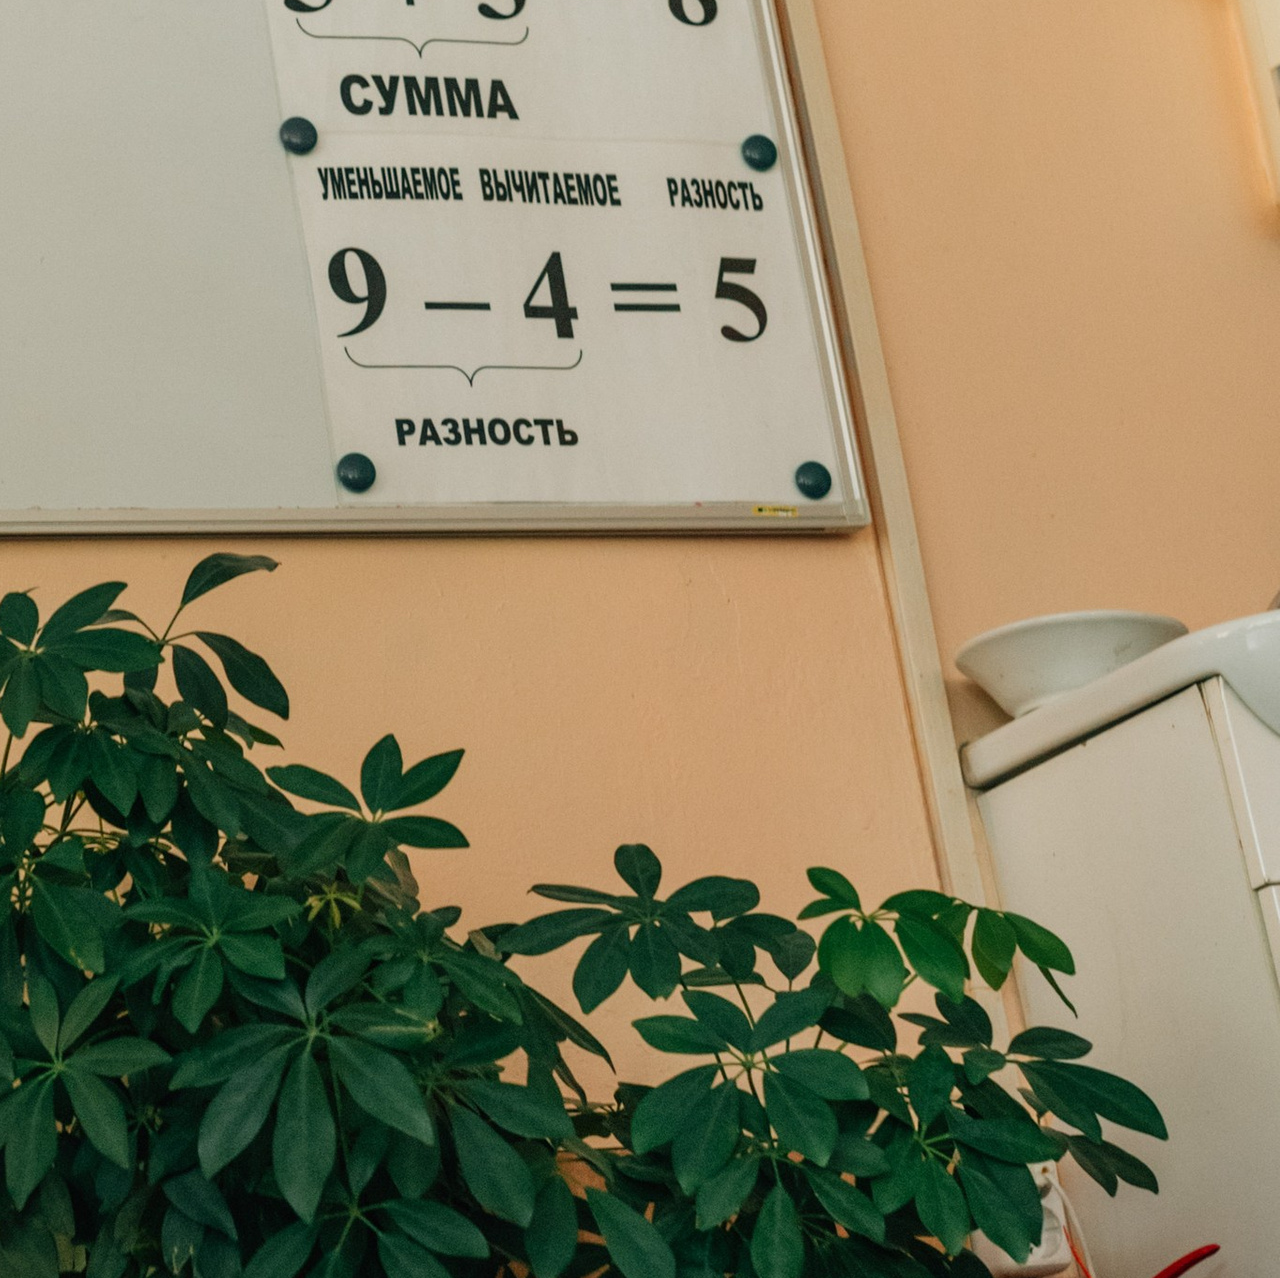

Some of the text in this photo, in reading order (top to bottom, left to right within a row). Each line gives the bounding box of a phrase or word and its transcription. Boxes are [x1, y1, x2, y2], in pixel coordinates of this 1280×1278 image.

[340, 74, 519, 120] СУММА
[318, 167, 763, 211] УМЕНЬШАЕМОЕ ВЫЧИТАЕМОЕ РАЗНОСТЬ
[328, 247, 387, 337] 9
[523, 252, 578, 339] 4
[611, 283, 680, 312] =
[715, 257, 767, 342] 5
[395, 418, 578, 446] РАЗНОСТЬ
